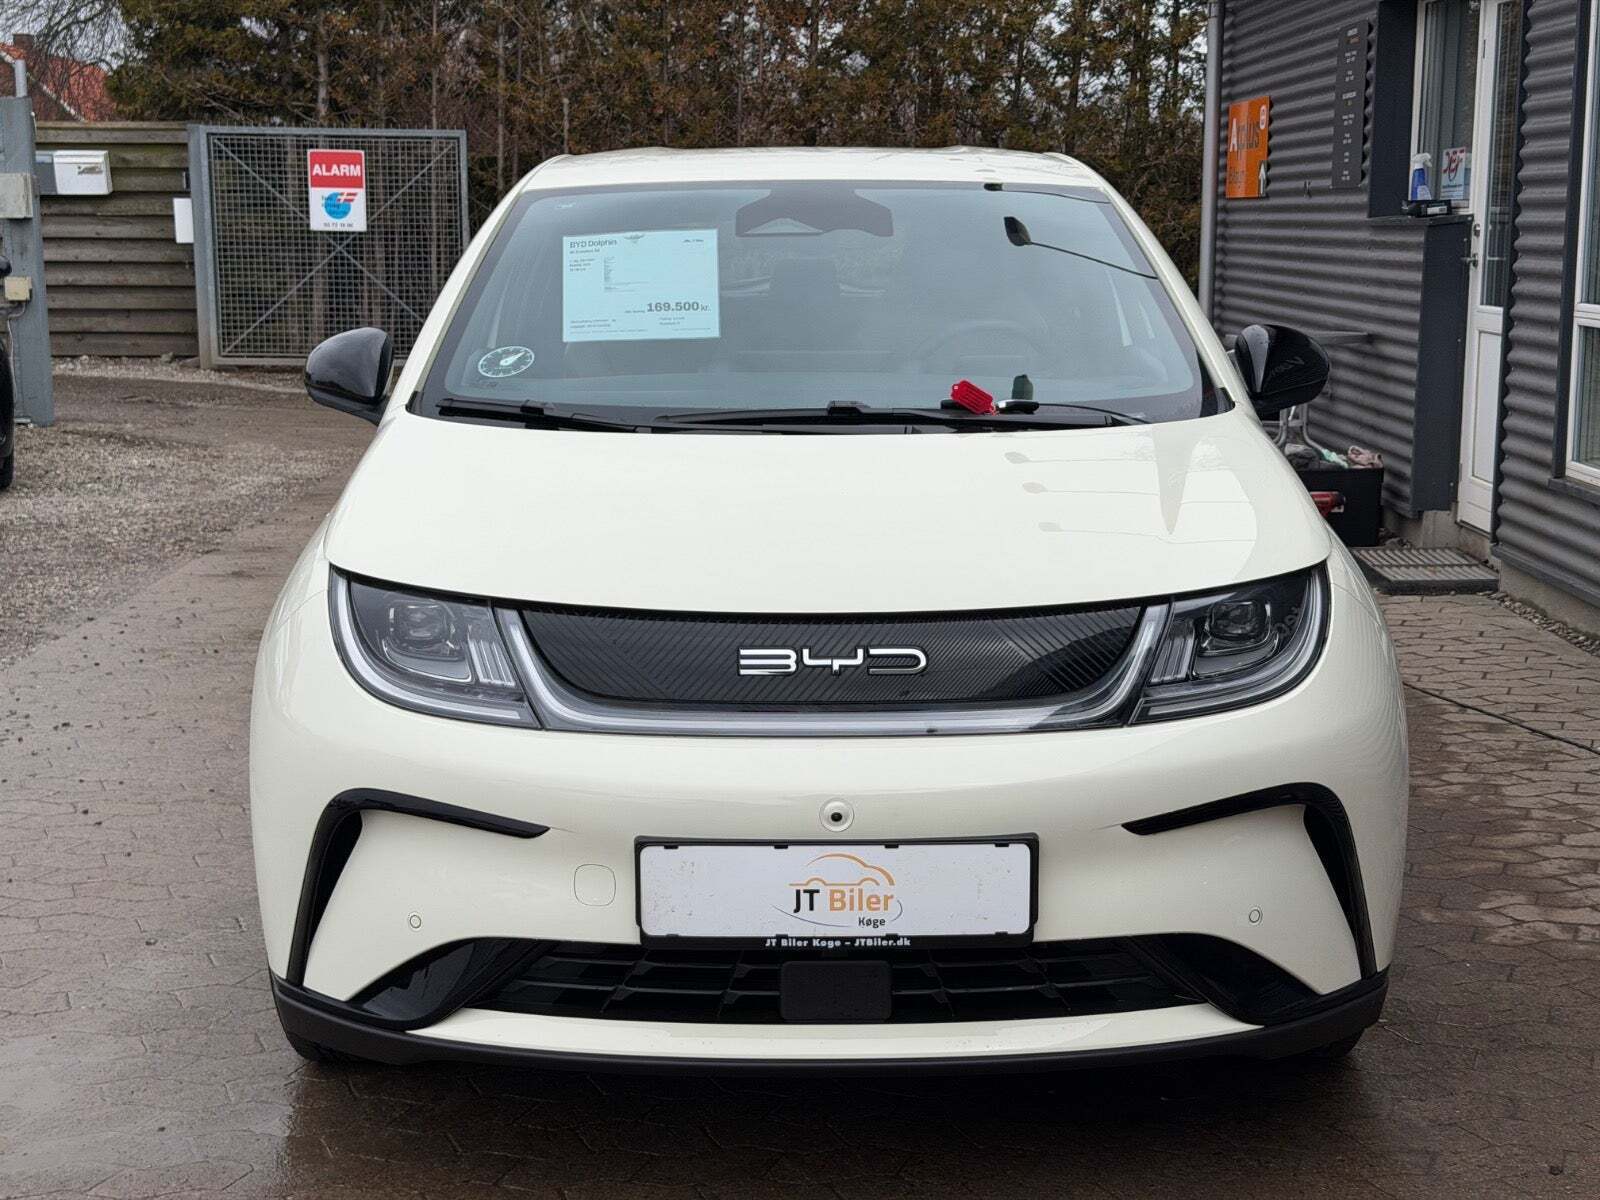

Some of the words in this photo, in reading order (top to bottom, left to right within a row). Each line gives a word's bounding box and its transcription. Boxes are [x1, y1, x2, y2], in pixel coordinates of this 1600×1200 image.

[312, 164, 361, 176] ALARM
[570, 241, 587, 249] BYD
[588, 240, 618, 248] Dolphin
[646, 301, 700, 312] 169.500
[701, 304, 712, 312] kr.
[738, 648, 927, 676] BYD
[793, 889, 820, 913] JT
[829, 889, 894, 912] Biler
[858, 917, 886, 929] Køge
[765, 938, 777, 947] JT
[781, 938, 808, 947] Biler
[854, 937, 911, 947] JTBiler.dk
